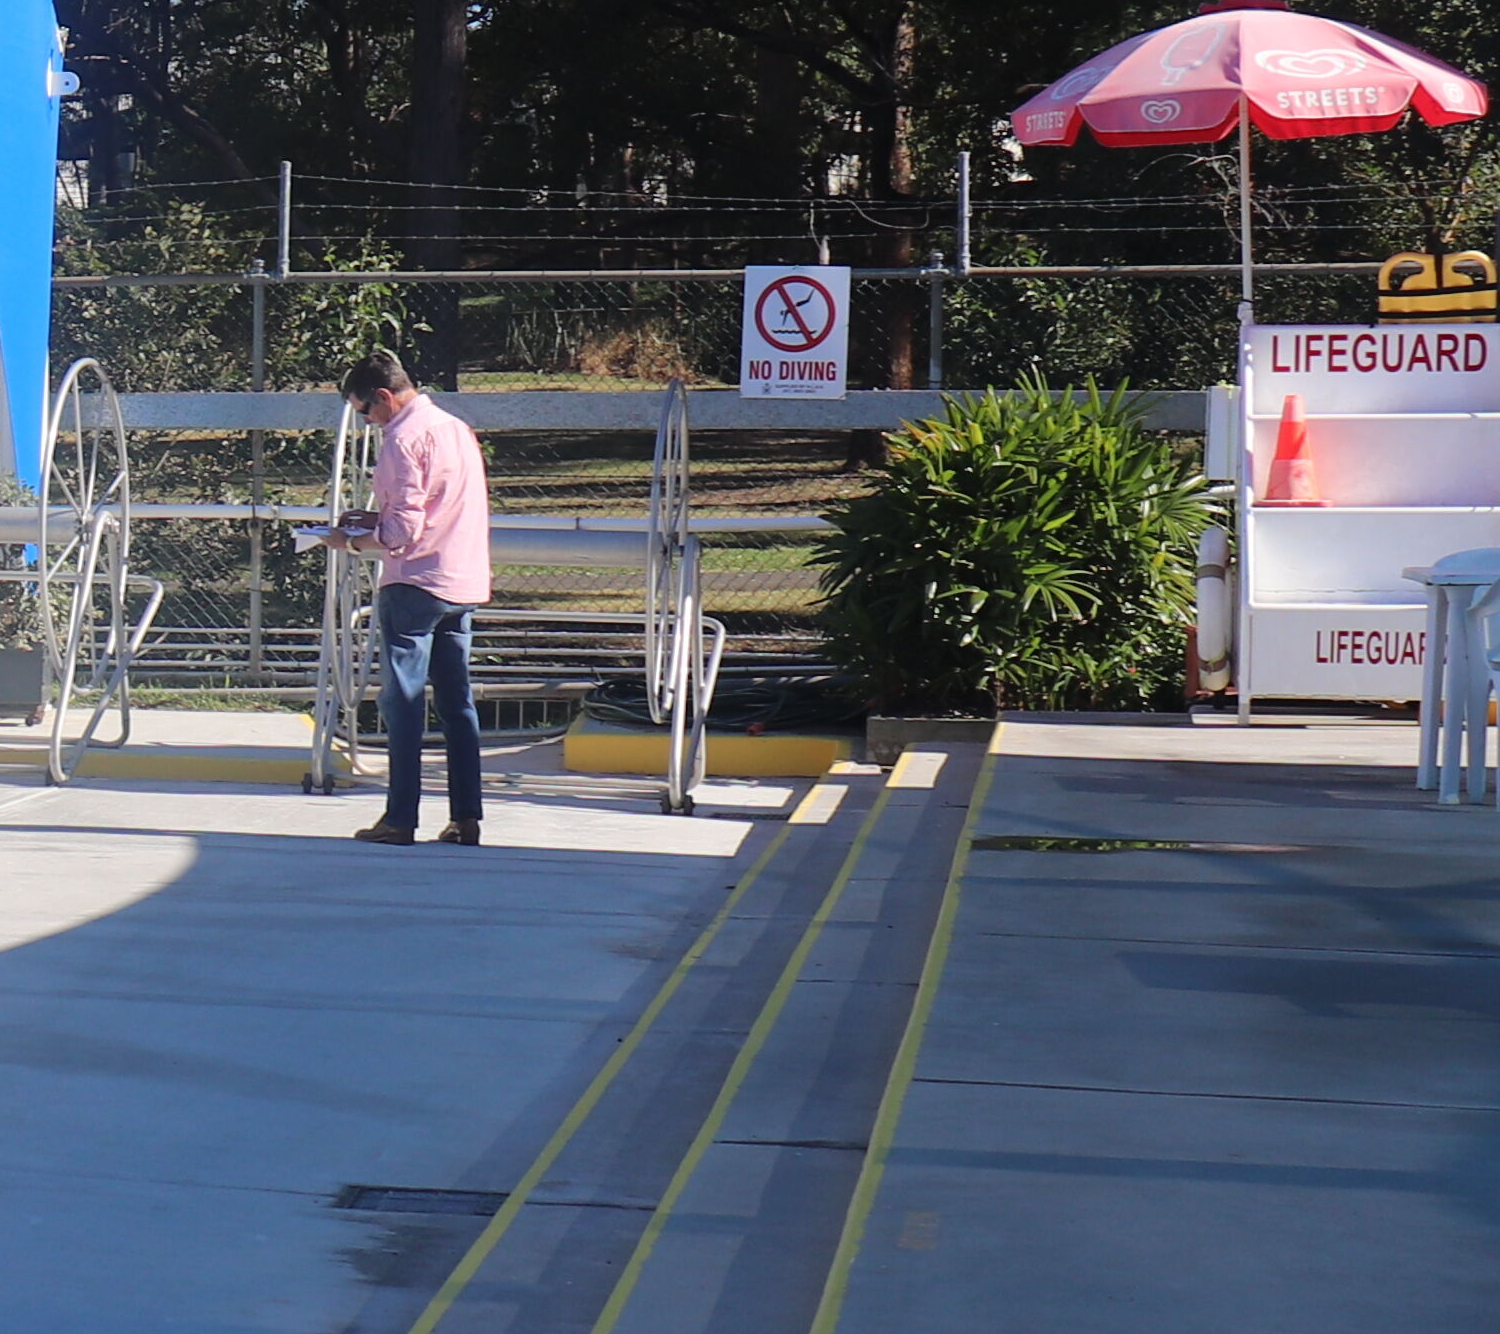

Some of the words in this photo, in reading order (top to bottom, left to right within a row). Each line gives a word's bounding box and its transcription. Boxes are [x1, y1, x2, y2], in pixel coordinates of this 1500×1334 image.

[1276, 87, 1379, 108] STREETS
[1272, 333, 1487, 373] LIFEGUARD
[749, 360, 772, 380] NO
[779, 361, 837, 381] DIVING
[1316, 631, 1446, 665] LIFEGUA
